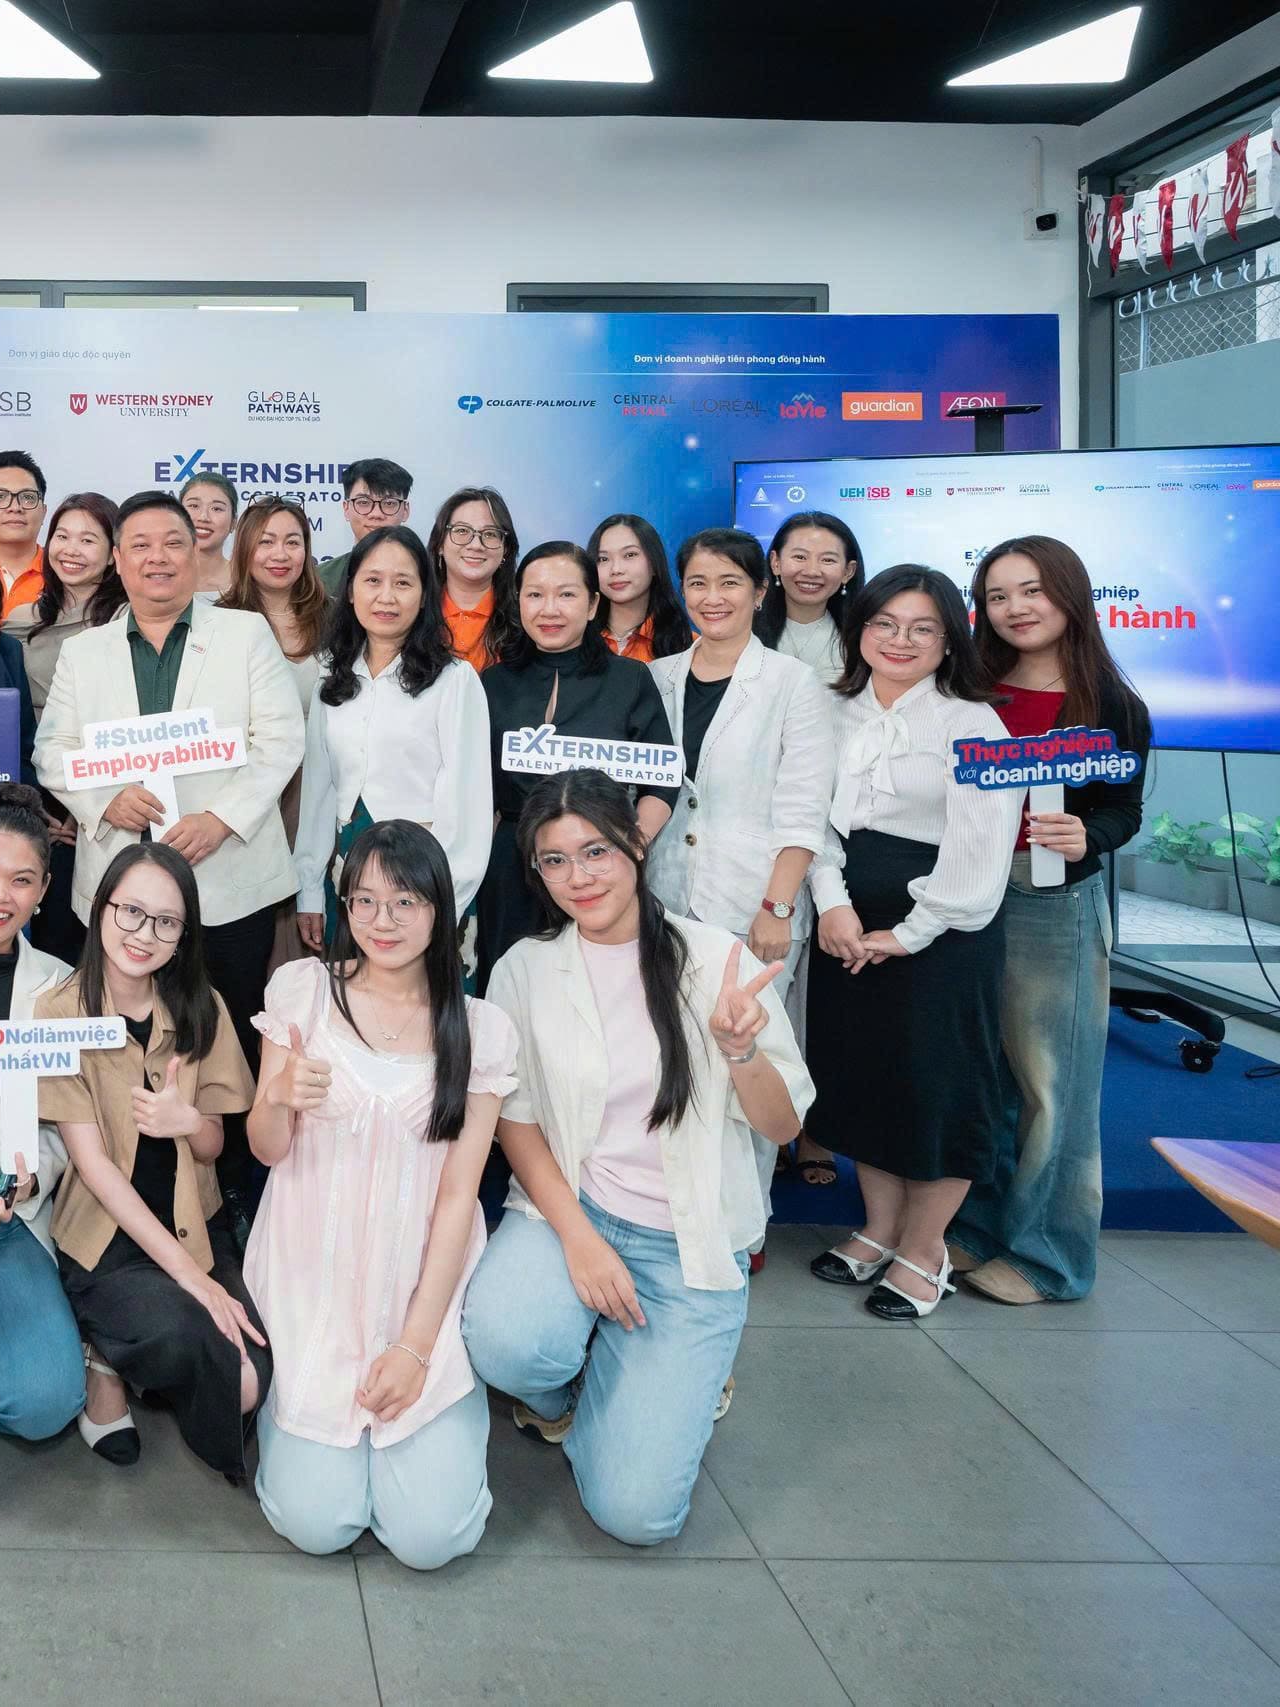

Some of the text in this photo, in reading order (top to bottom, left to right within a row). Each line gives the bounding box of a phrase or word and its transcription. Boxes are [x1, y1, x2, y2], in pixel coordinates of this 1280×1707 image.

[634, 354, 653, 363] Đơn
[664, 354, 693, 363] doanh
[694, 354, 726, 365] nghiệp
[747, 354, 776, 365] phong
[802, 354, 826, 364] hành
[96, 394, 214, 406] WESTERN SYDNEY
[248, 391, 320, 403] GLOBAL
[487, 399, 597, 407] COLGATE-PALMOLIVE
[613, 394, 675, 405] CENTRAL
[120, 407, 189, 417] UNIVERSITY
[248, 403, 320, 413] PATHWAYS
[623, 406, 668, 416] RETAIL
[850, 398, 915, 415] guardian
[840, 487, 865, 498] UEH
[915, 487, 932, 496] ISB
[1091, 586, 1139, 601] ghiệp
[1109, 604, 1196, 629] hành
[94, 717, 209, 749] #Student
[508, 728, 678, 767] EXTERNSHIP
[959, 733, 1112, 765] Thực nghiệm
[72, 740, 236, 778] Employability
[508, 758, 562, 771] TALENT
[959, 754, 1136, 785] với doanh nghiệp
